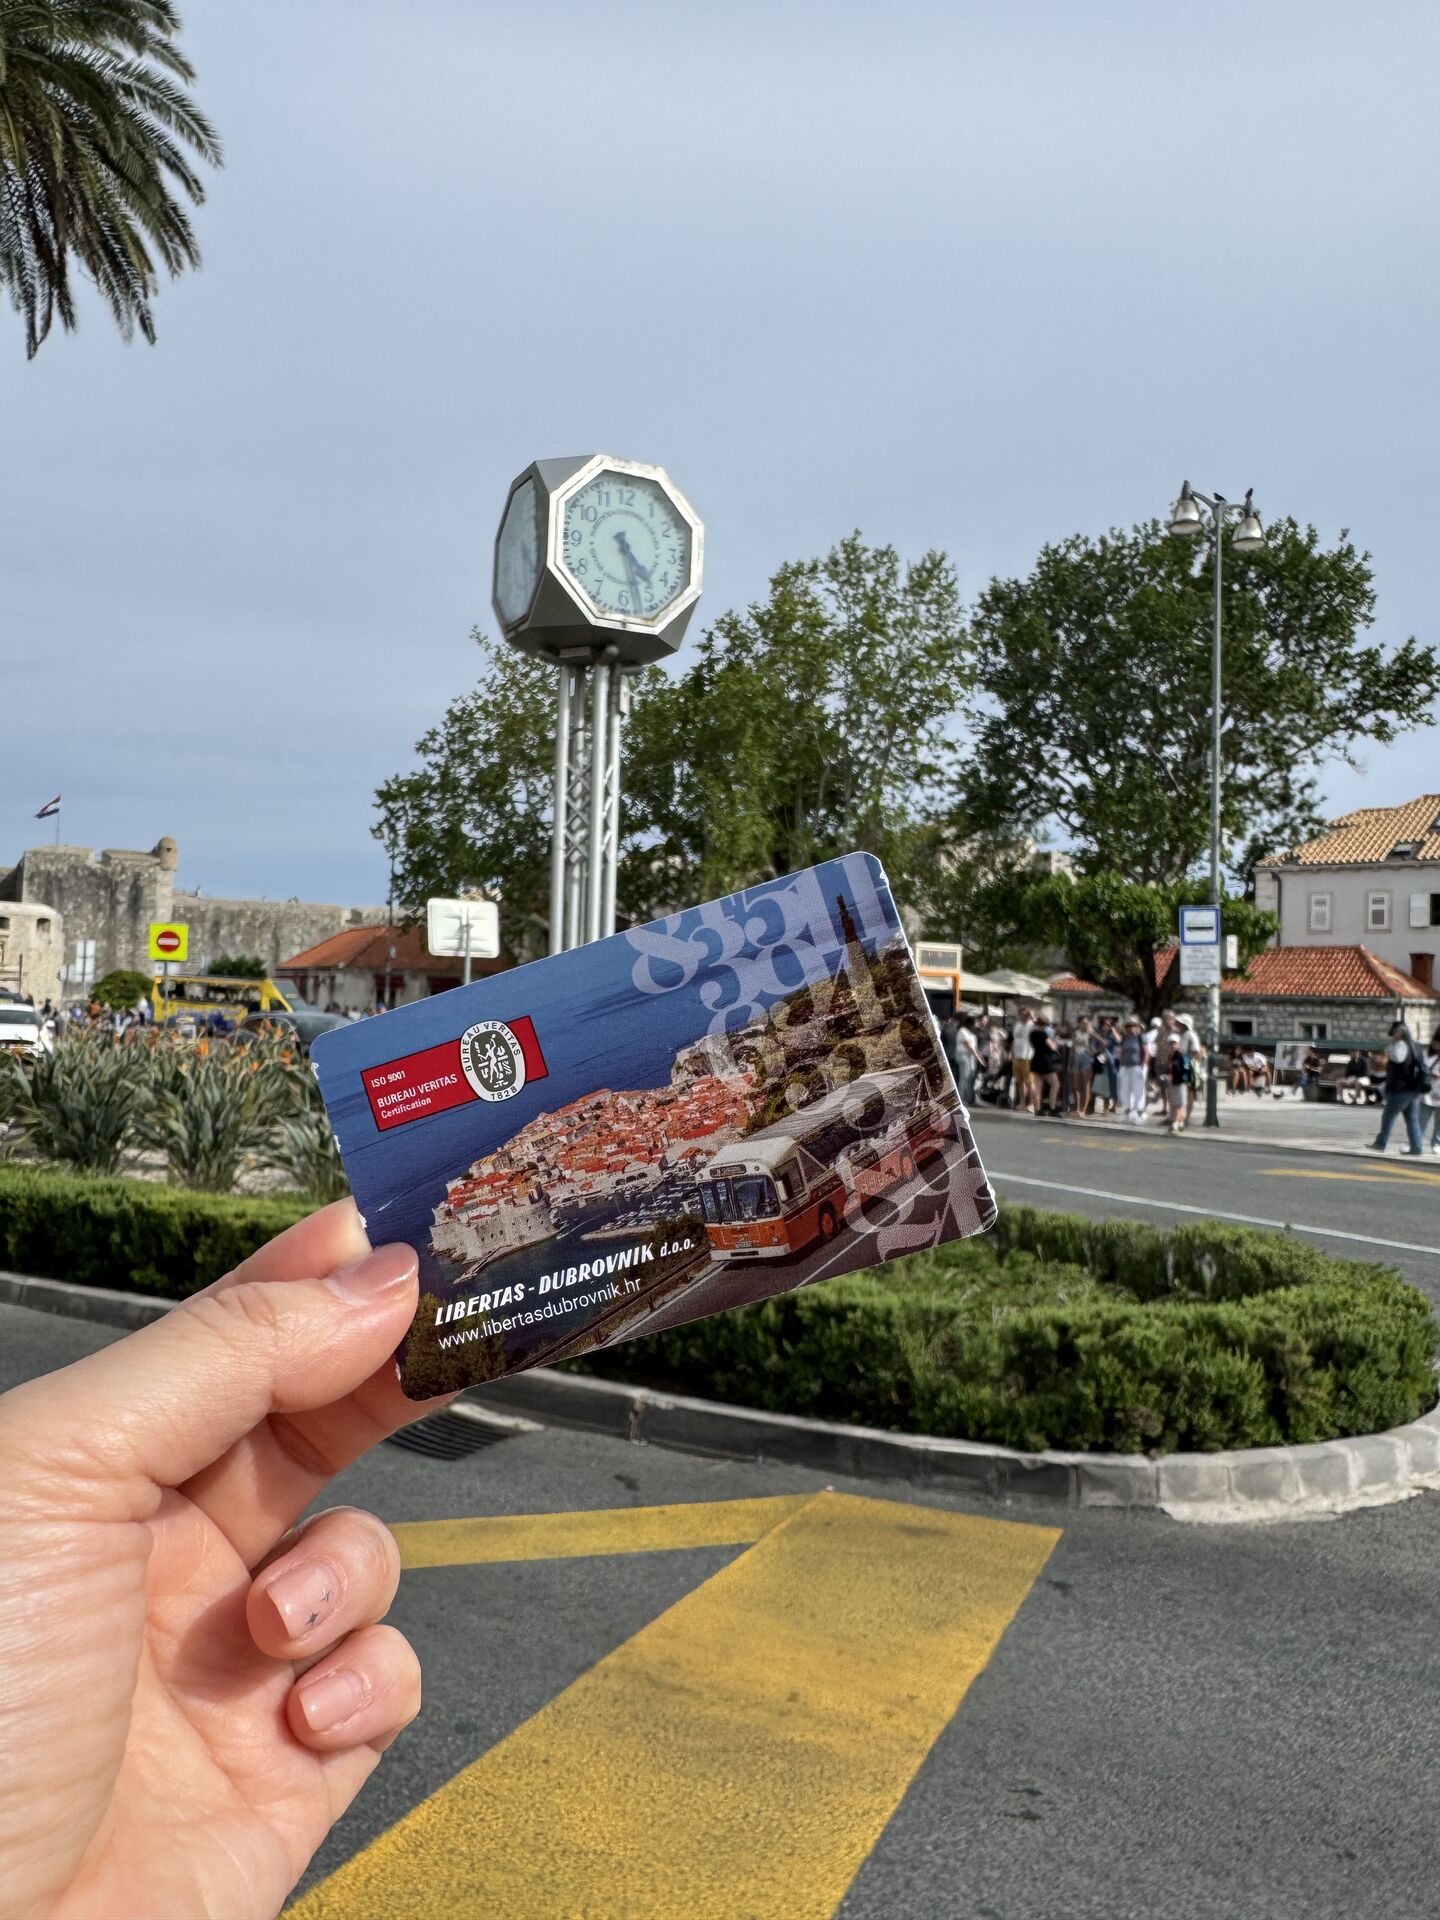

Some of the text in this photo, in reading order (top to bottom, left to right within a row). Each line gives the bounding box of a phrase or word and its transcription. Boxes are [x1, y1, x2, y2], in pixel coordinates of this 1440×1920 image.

[596, 489, 611, 508] 11
[617, 488, 636, 507] 12
[580, 503, 598, 523] 10
[570, 529, 582, 547] 9
[661, 521, 672, 538] 2
[576, 557, 588, 576] 8
[618, 590, 629, 607] 6
[461, 1021, 521, 1073] BUREAU VERITAS
[370, 1069, 406, 1088] ISO 9001
[376, 1073, 458, 1108] BUREAU VERITAS
[490, 1085, 518, 1101] 1828
[380, 1096, 432, 1119] Certification
[435, 1282, 525, 1327] LIBERTAS
[538, 1243, 655, 1296] DUBROVNIK
[659, 1237, 696, 1258] d.o.o.
[438, 1275, 642, 1350] www.libertasdubrovnik.hr
